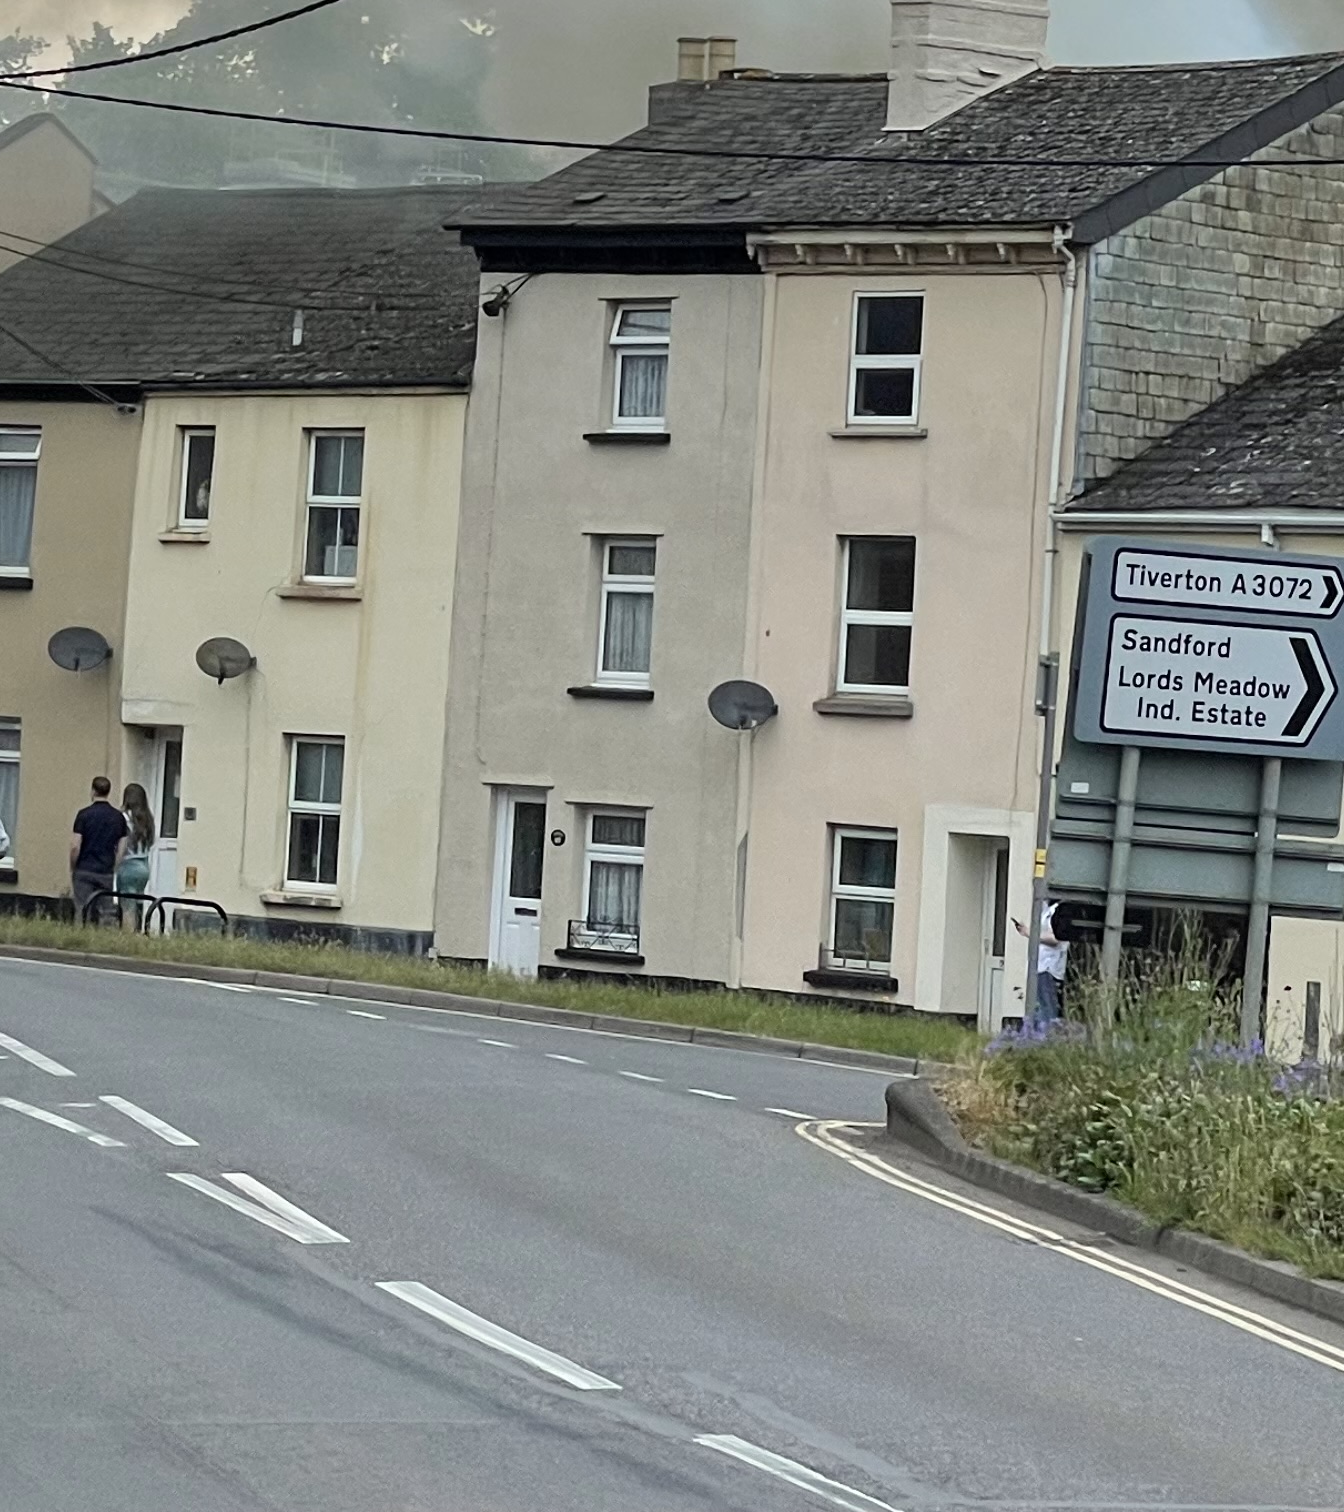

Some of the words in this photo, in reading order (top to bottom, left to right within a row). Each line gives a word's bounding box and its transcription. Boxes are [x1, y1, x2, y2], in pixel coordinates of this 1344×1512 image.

[1125, 563, 1222, 593] Tiverton
[1120, 629, 1232, 659] Sandford
[1118, 665, 1183, 691] Lords
[1194, 671, 1291, 700] Meadow
[1137, 697, 1181, 722] Ind.
[1191, 701, 1267, 728] Estate
